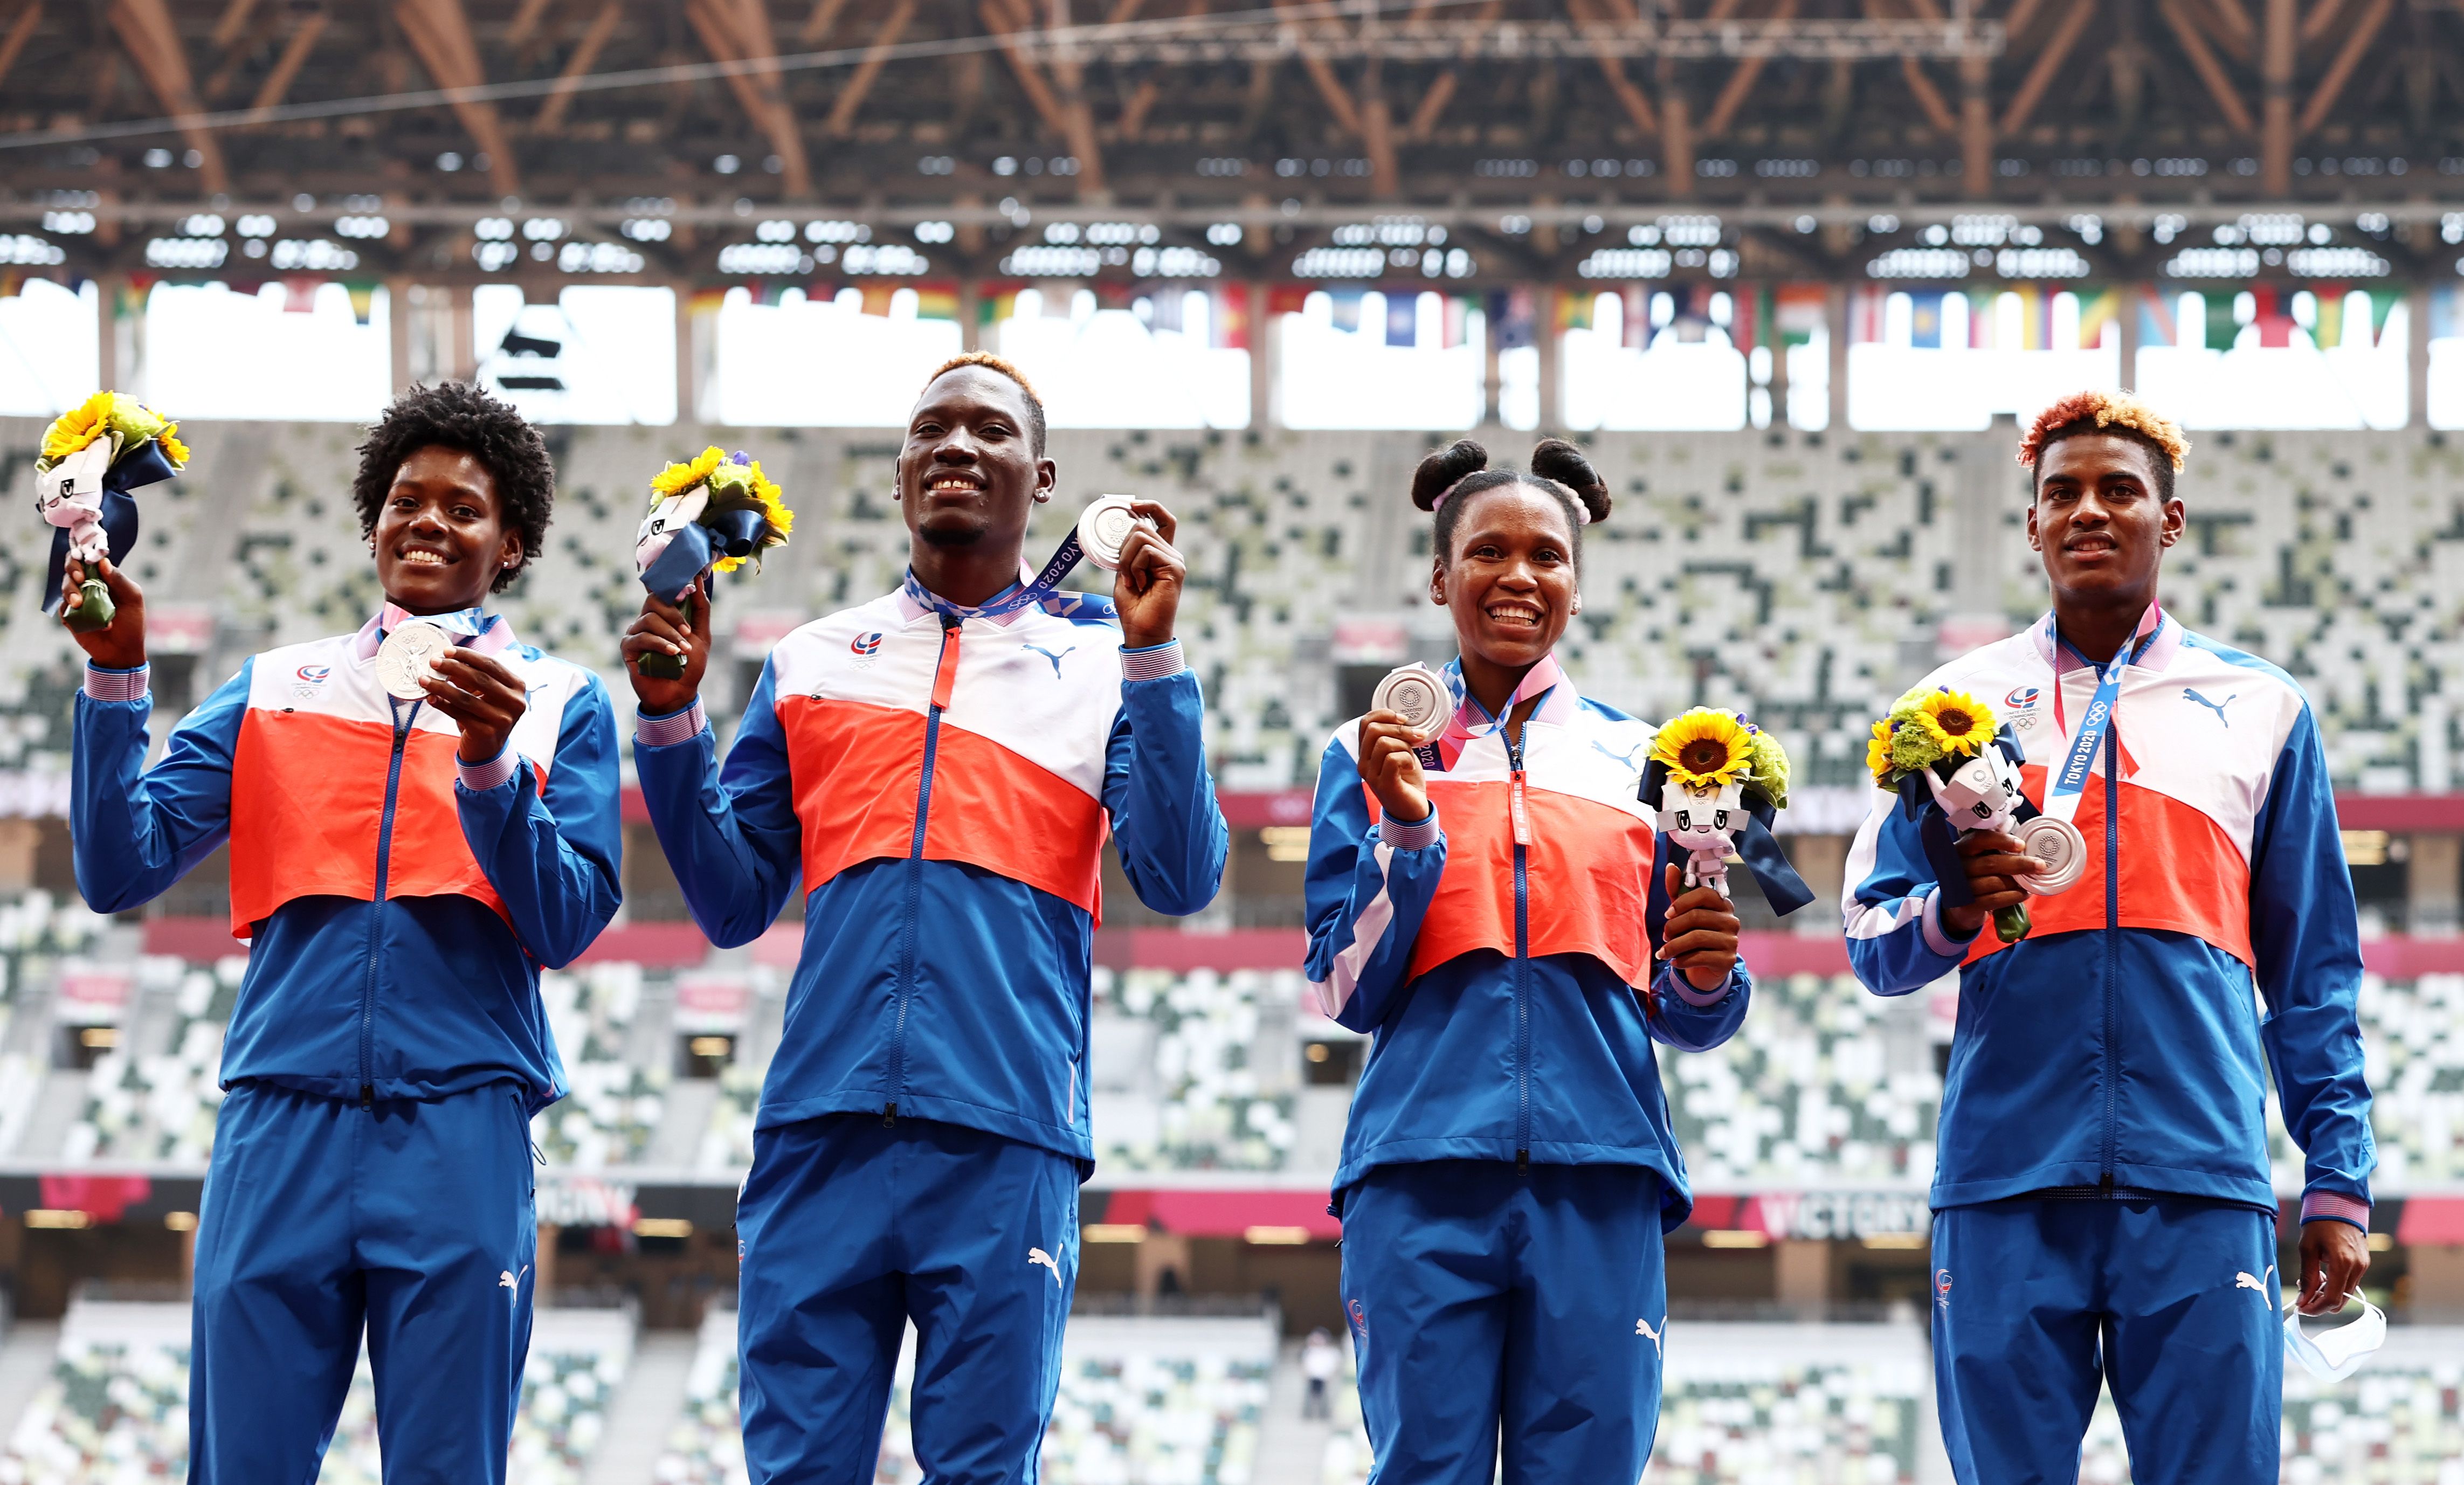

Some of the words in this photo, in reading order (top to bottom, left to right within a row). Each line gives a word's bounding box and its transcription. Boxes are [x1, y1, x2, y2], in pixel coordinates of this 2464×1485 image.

[1038, 561, 1065, 589] 2020
[2064, 755, 2088, 784] TOKYO
[2077, 730, 2097, 754] 2020
[1758, 1193, 1931, 1240] VICTORY
